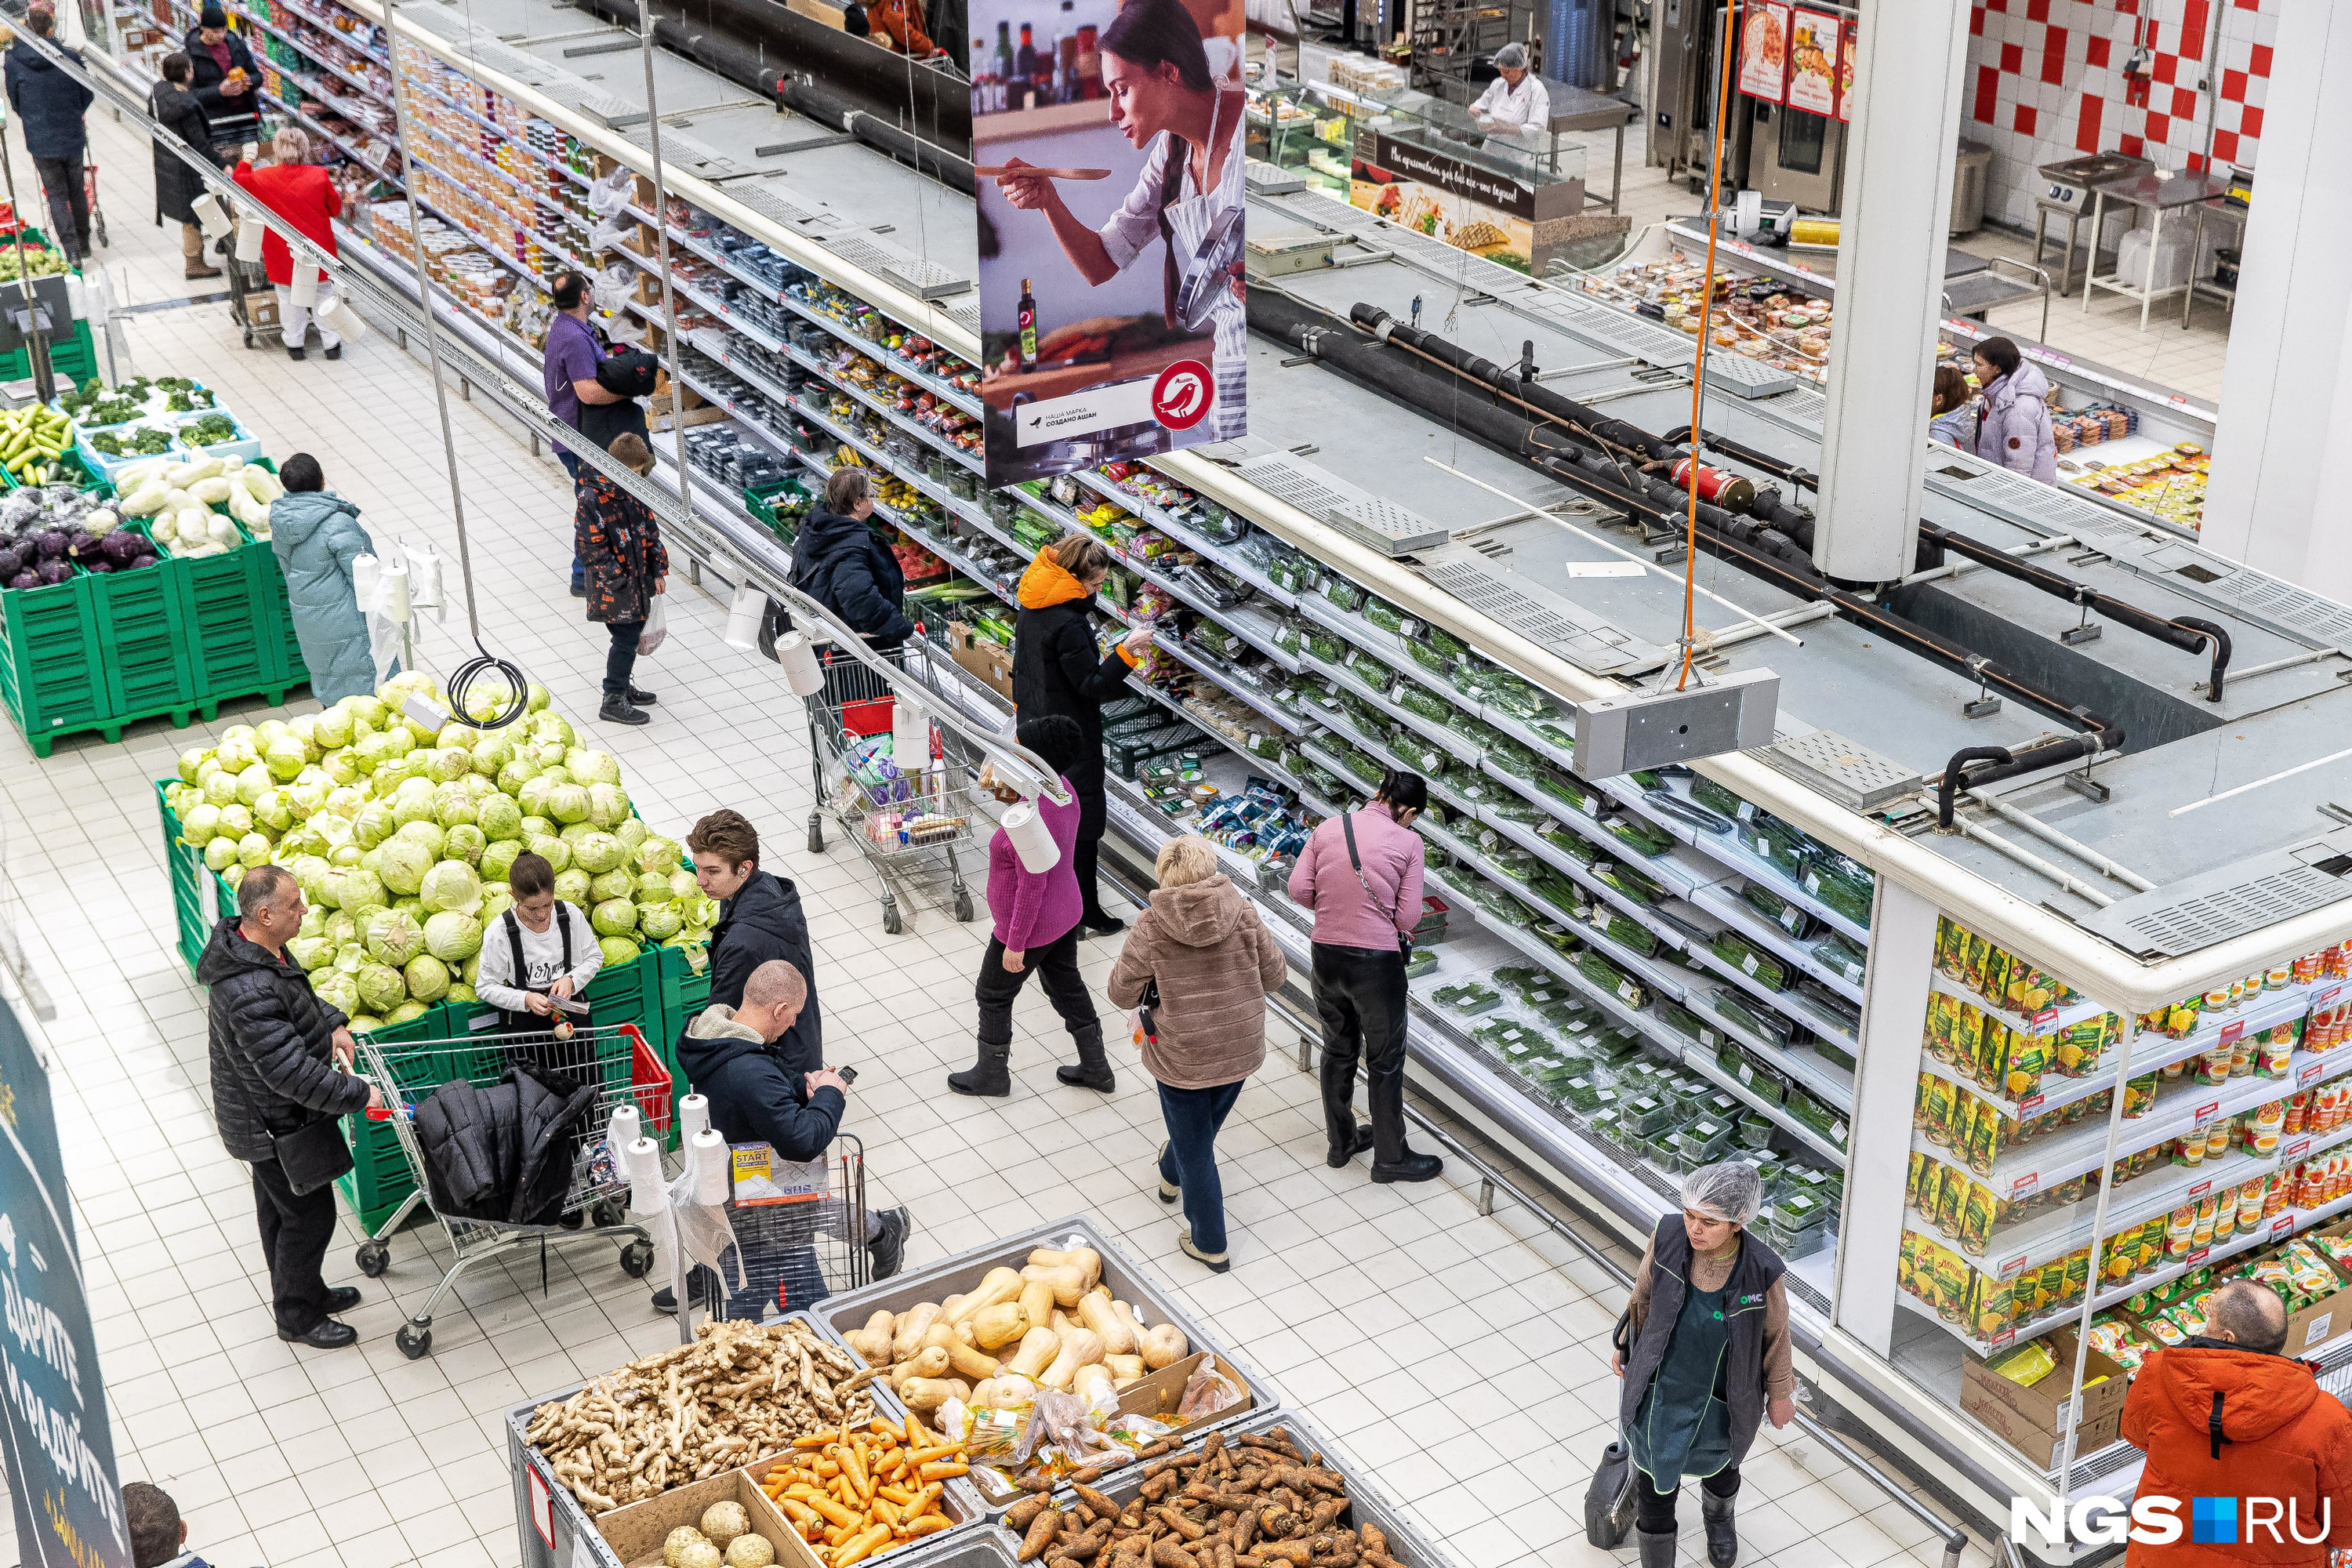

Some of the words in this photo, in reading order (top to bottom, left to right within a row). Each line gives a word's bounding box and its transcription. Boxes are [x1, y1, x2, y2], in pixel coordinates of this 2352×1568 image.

[1065, 408, 1087, 416] МАРКА
[1046, 416, 1076, 427] СОЗДАНО
[2037, 1011, 2055, 1022] СКИДКА
[2024, 1098, 2041, 1108] СКИДКА
[736, 1152, 768, 1162] START
